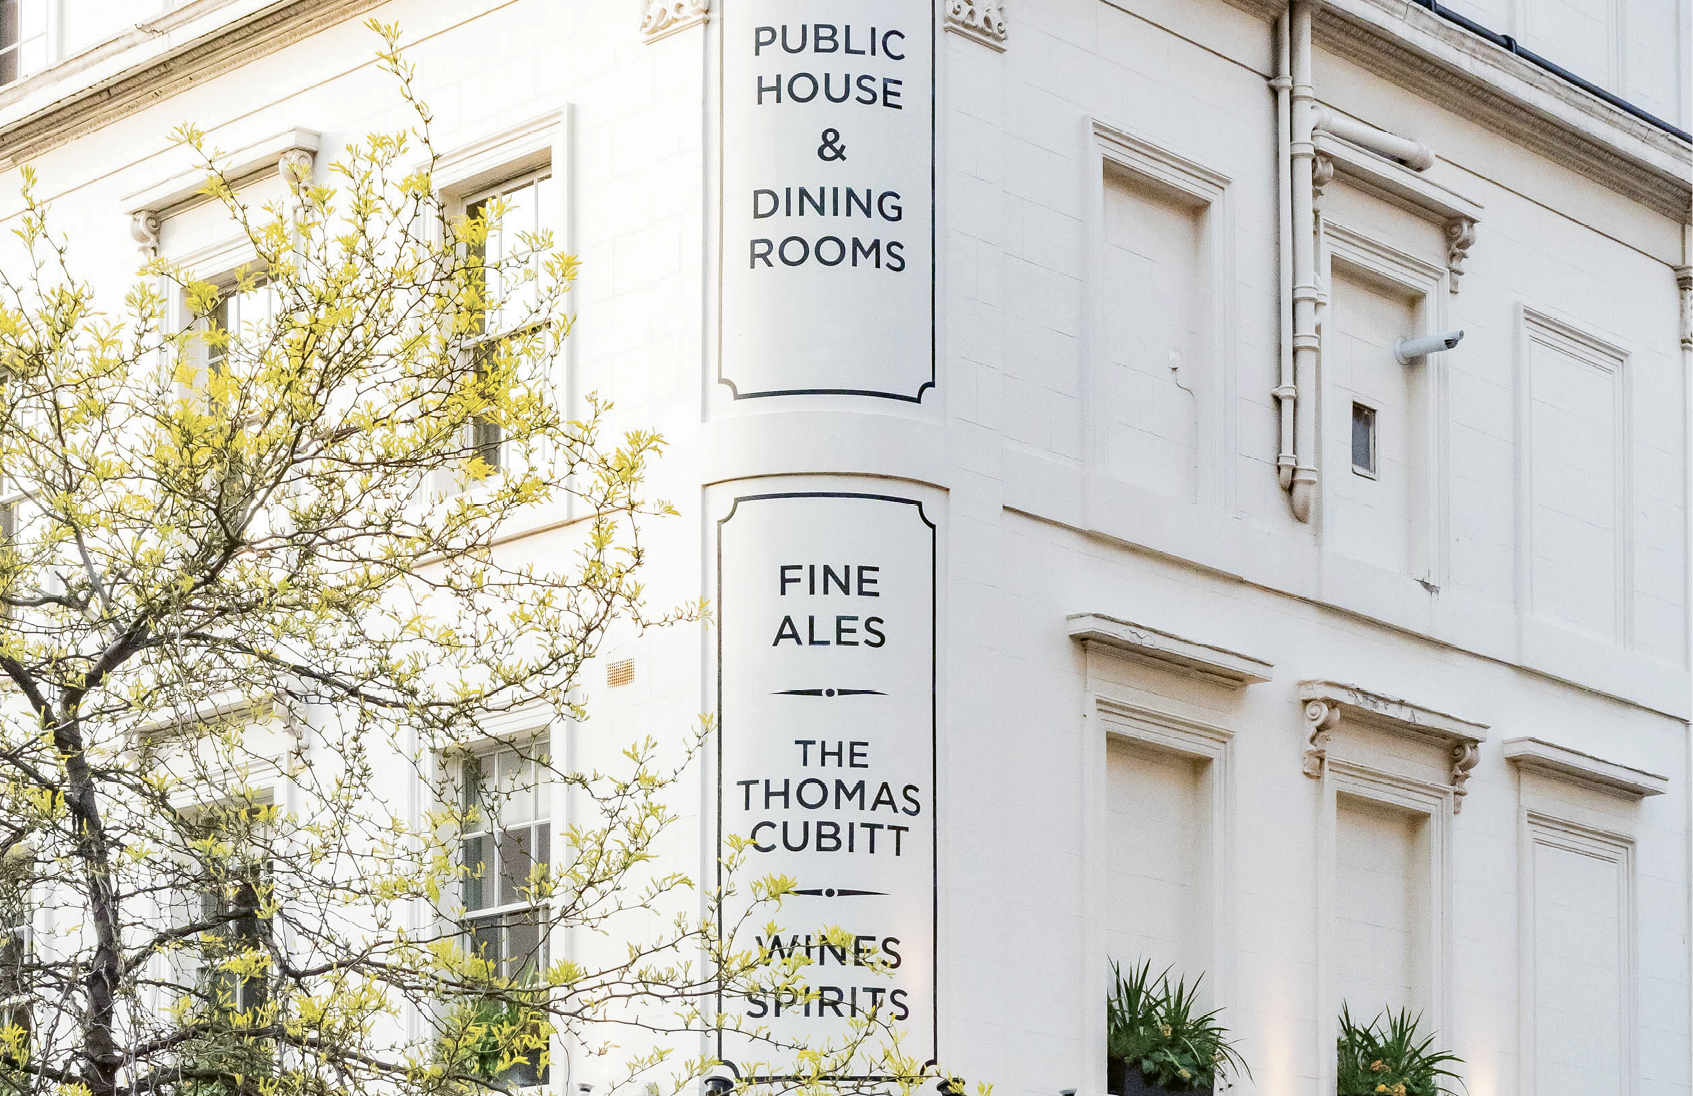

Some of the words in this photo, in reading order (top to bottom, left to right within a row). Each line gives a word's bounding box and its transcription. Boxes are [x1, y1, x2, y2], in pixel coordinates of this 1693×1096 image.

[754, 23, 906, 61] PUBLIC
[757, 72, 903, 110] HOUSE
[817, 128, 847, 162] &
[753, 186, 903, 222] DINING
[750, 235, 906, 272] ROOMS
[780, 564, 880, 597] FINE
[772, 615, 886, 648] ALES
[794, 739, 869, 768] THE
[736, 777, 921, 816] THOMAS
[750, 820, 909, 857] CUBITT
[755, 934, 901, 969] WINES
[746, 986, 909, 1021] SPIRITS
